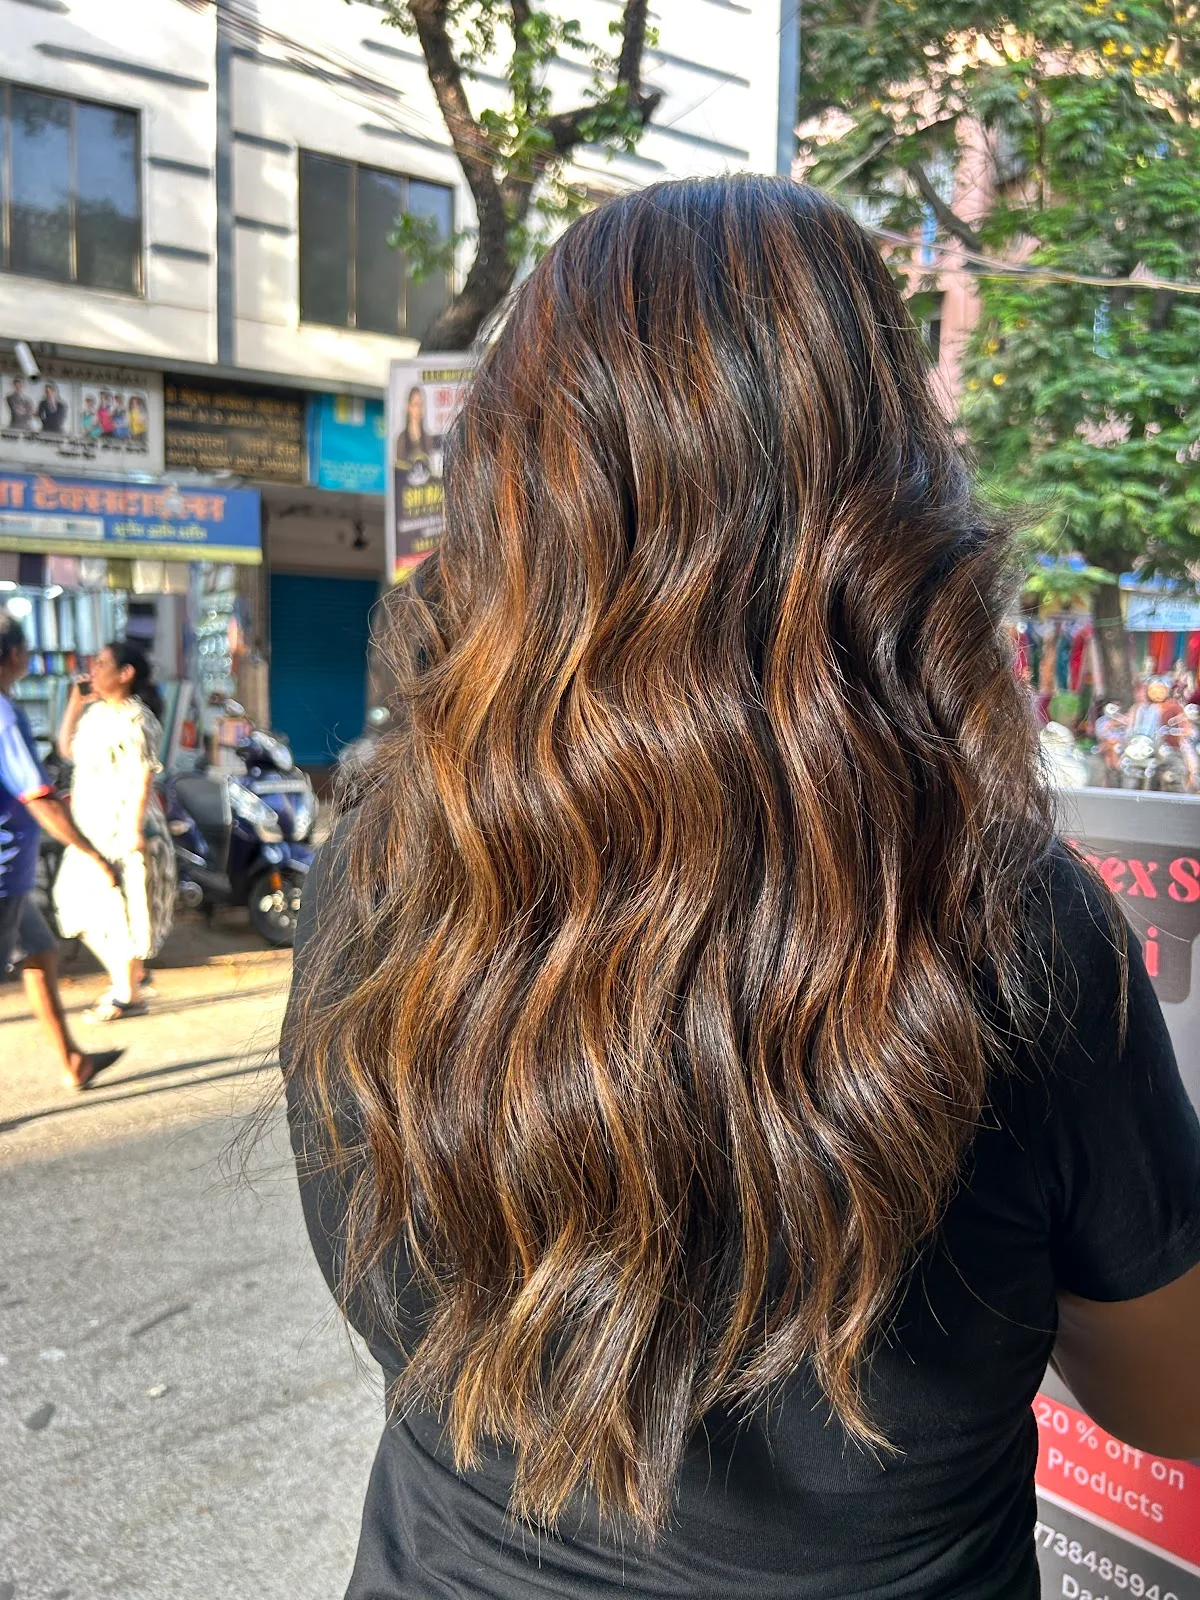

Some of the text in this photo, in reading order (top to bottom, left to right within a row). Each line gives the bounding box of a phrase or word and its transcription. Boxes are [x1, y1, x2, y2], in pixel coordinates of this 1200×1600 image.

[1037, 1401, 1185, 1491] 20 % off on
[1047, 1446, 1164, 1523] Products
